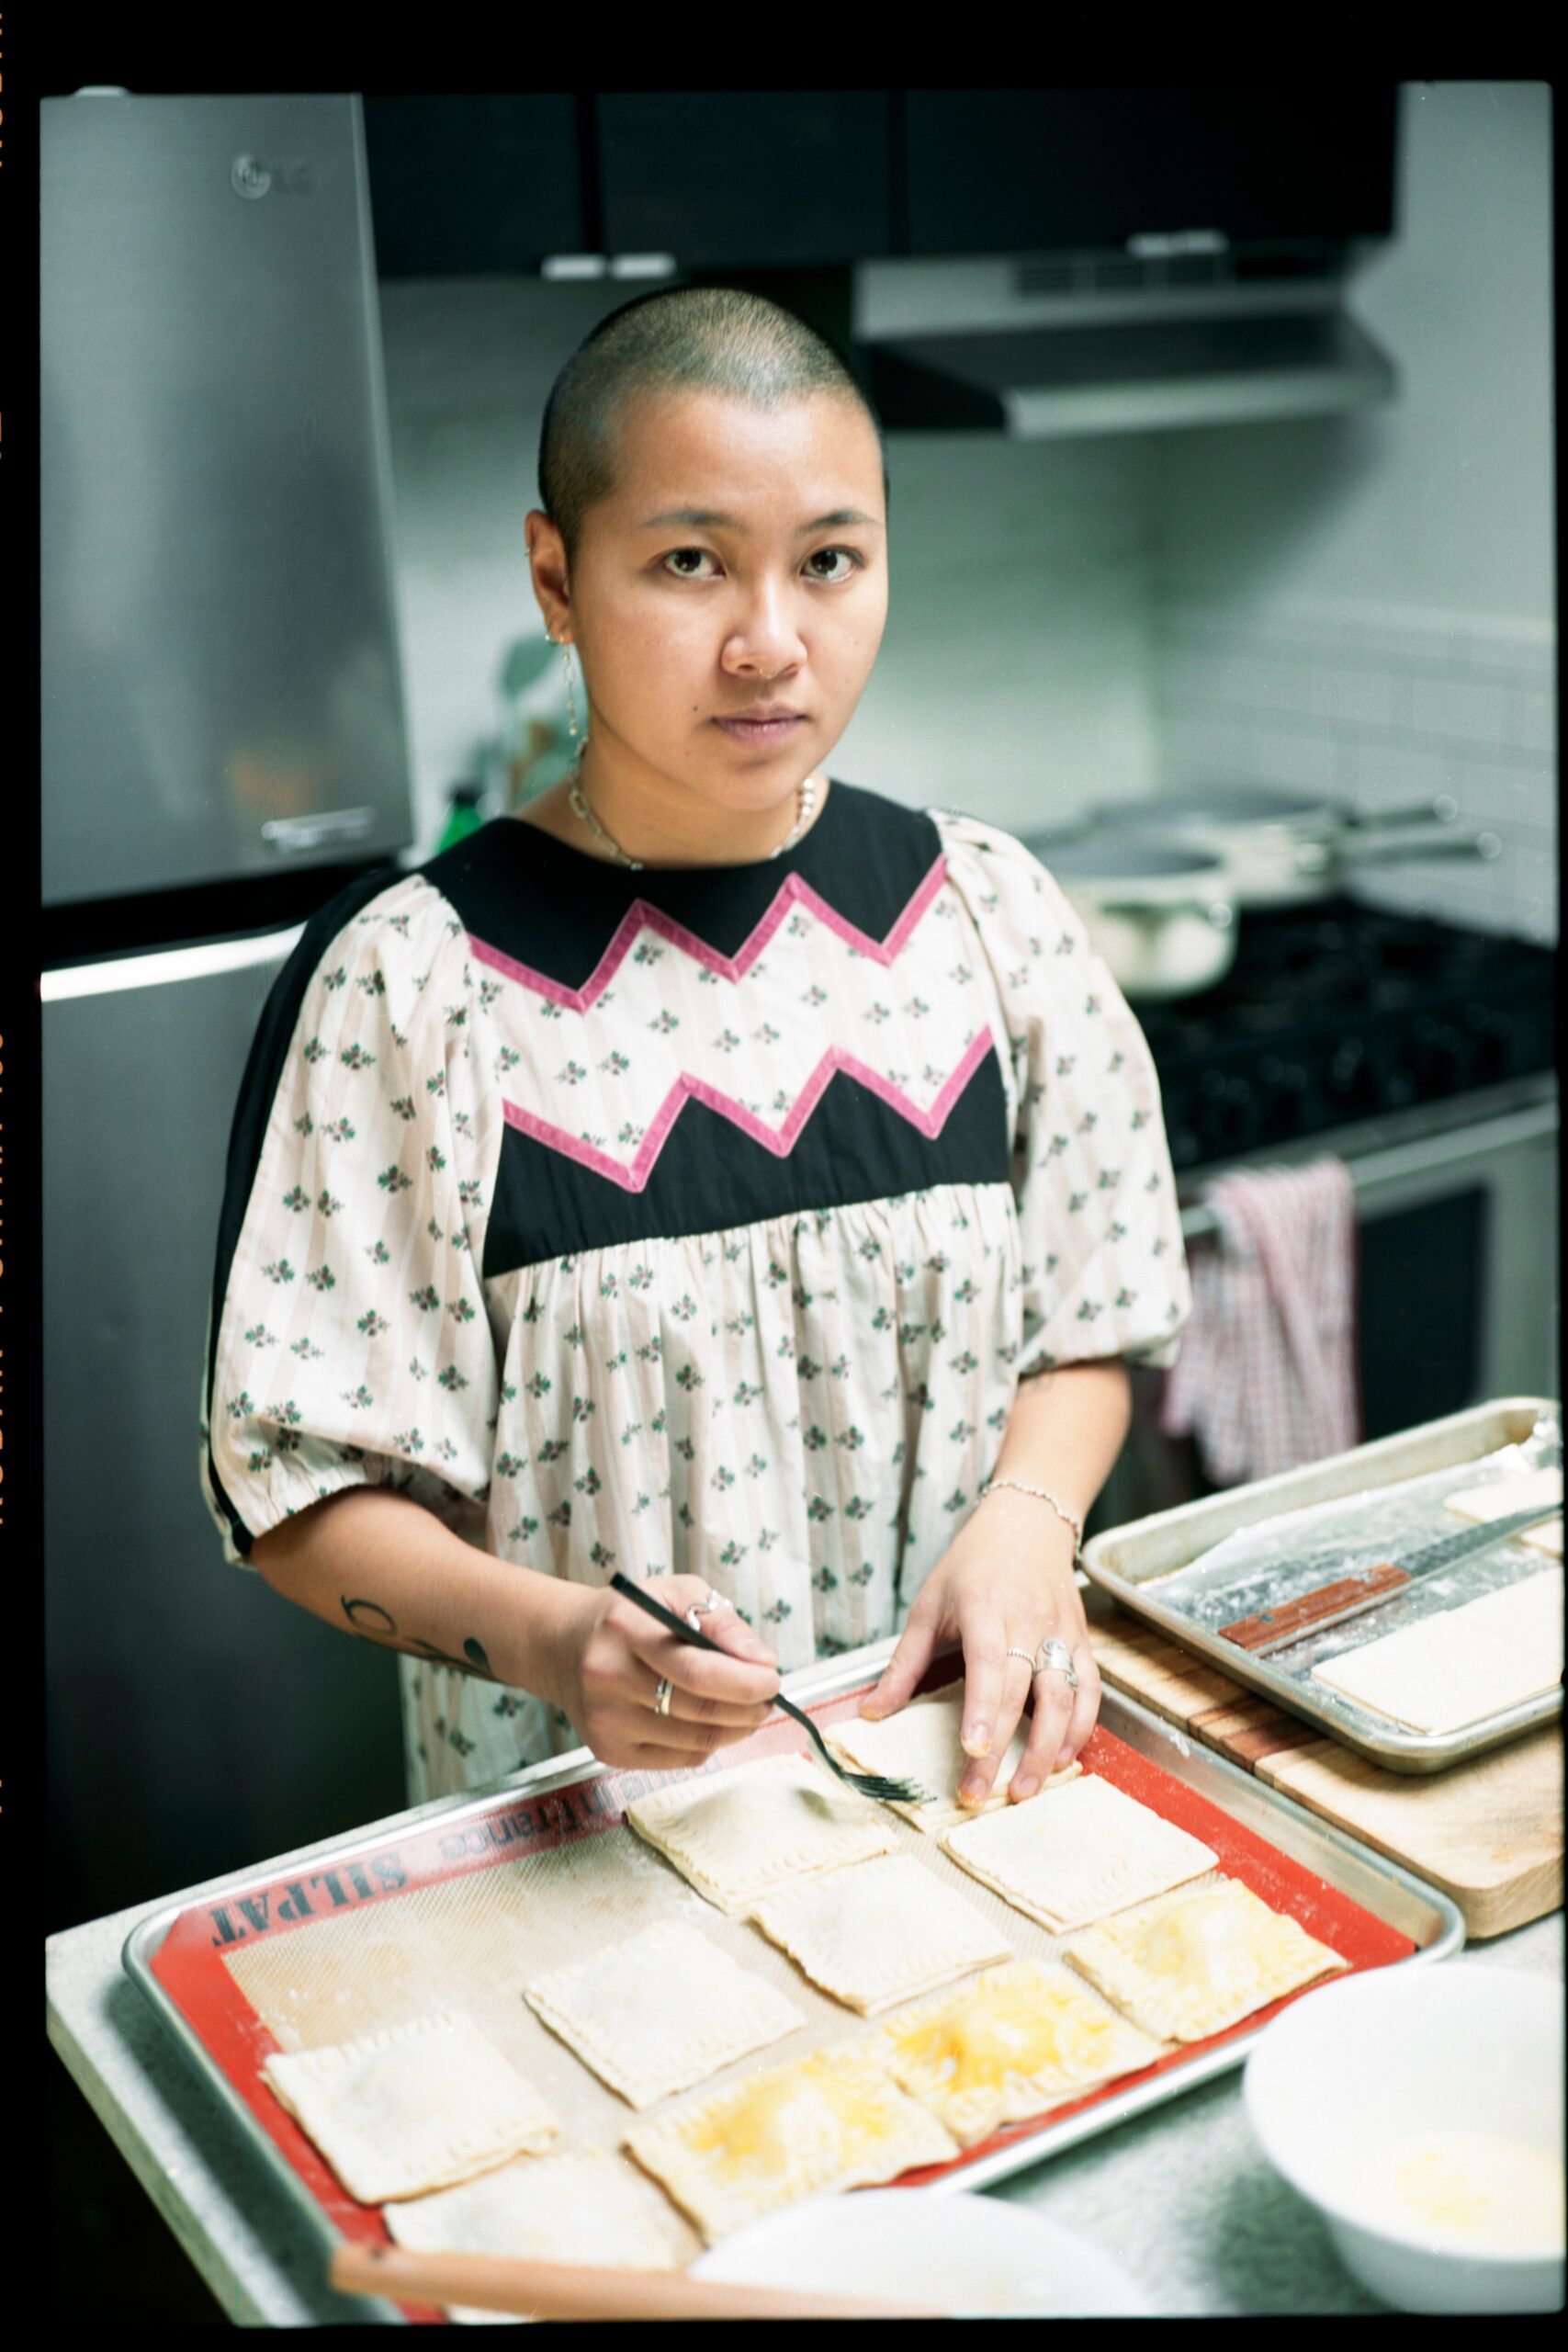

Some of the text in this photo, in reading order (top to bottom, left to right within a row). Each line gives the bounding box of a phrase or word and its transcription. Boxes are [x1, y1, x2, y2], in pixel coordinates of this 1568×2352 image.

[440, 1796, 581, 1860] France
[579, 1783, 622, 1817] in
[209, 1852, 408, 1947] SILPAT
